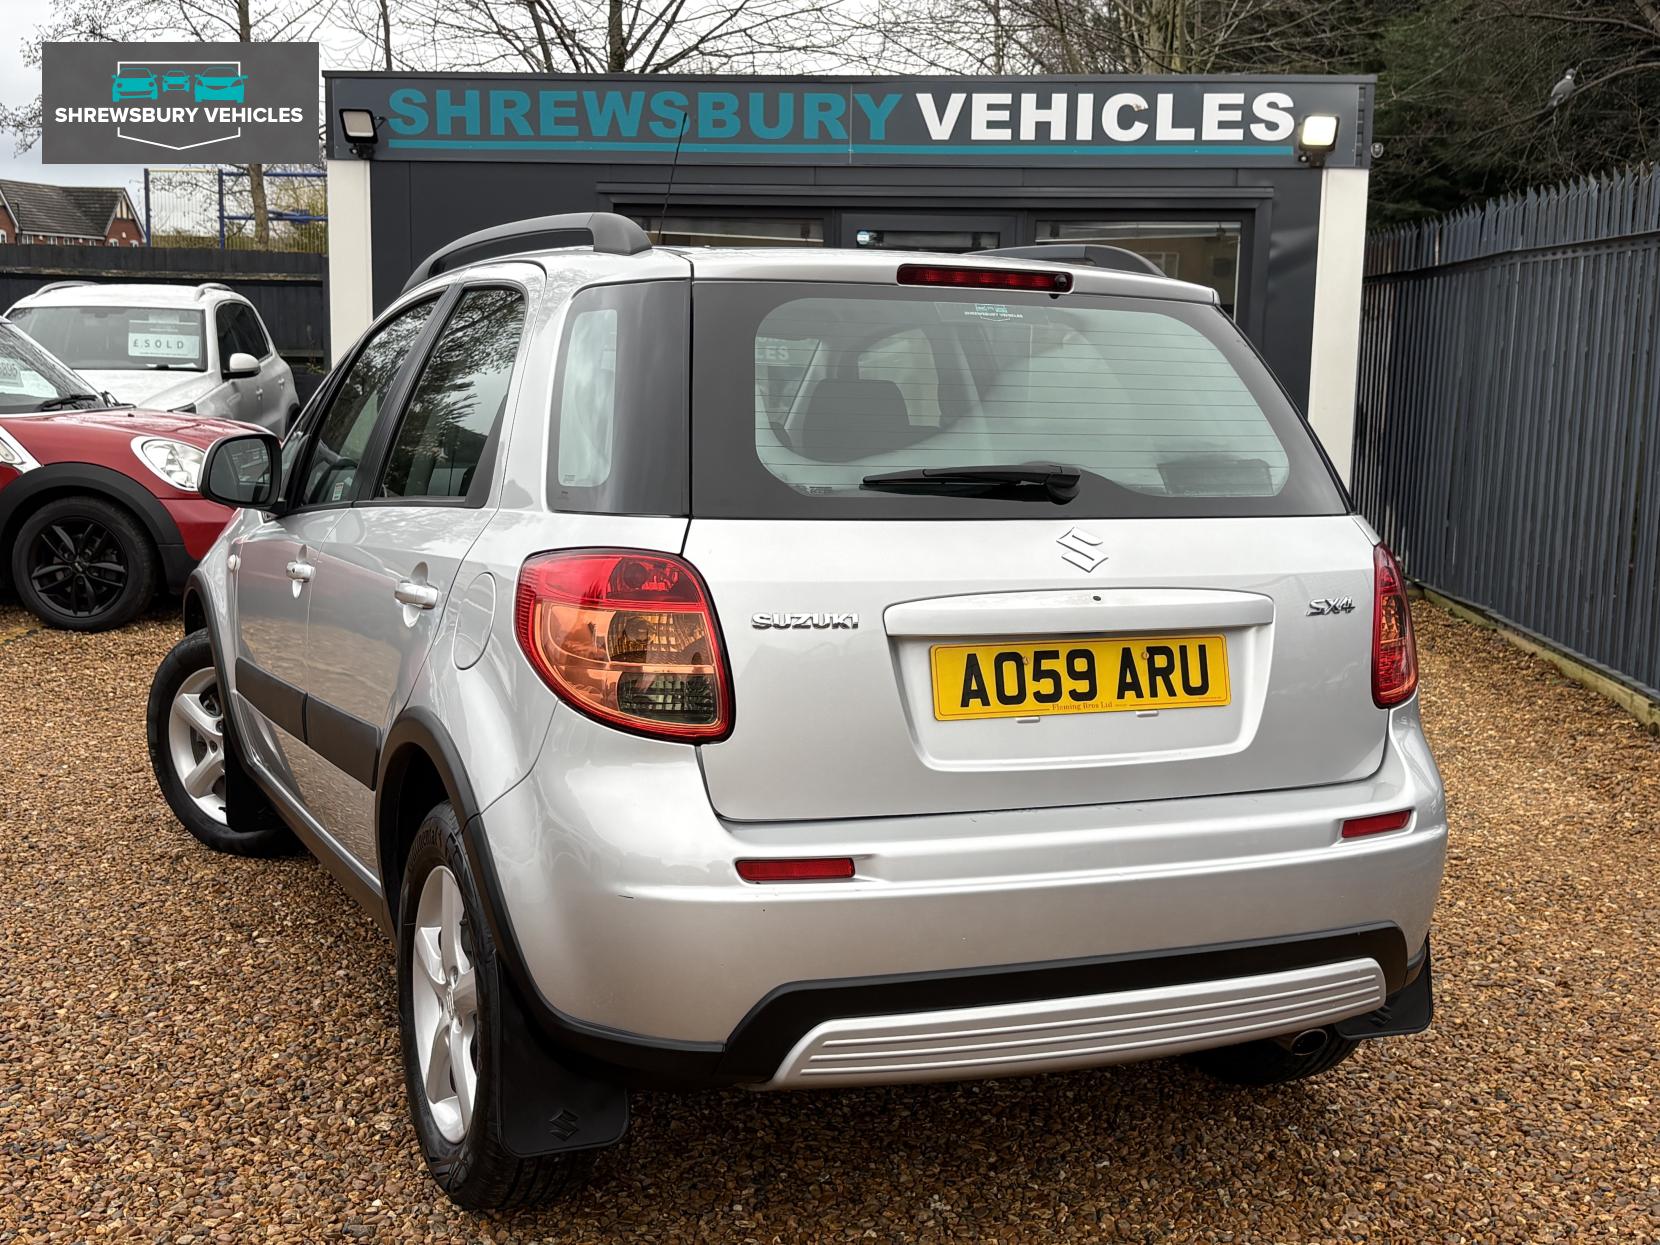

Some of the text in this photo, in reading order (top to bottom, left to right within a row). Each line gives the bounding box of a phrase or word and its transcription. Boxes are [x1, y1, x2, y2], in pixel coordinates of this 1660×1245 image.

[387, 87, 1296, 142] SHREWSBURY VEHICLES
[752, 612, 860, 630] SUZUKI
[1306, 596, 1356, 617] SX4
[959, 643, 1210, 709] AO59 ARU
